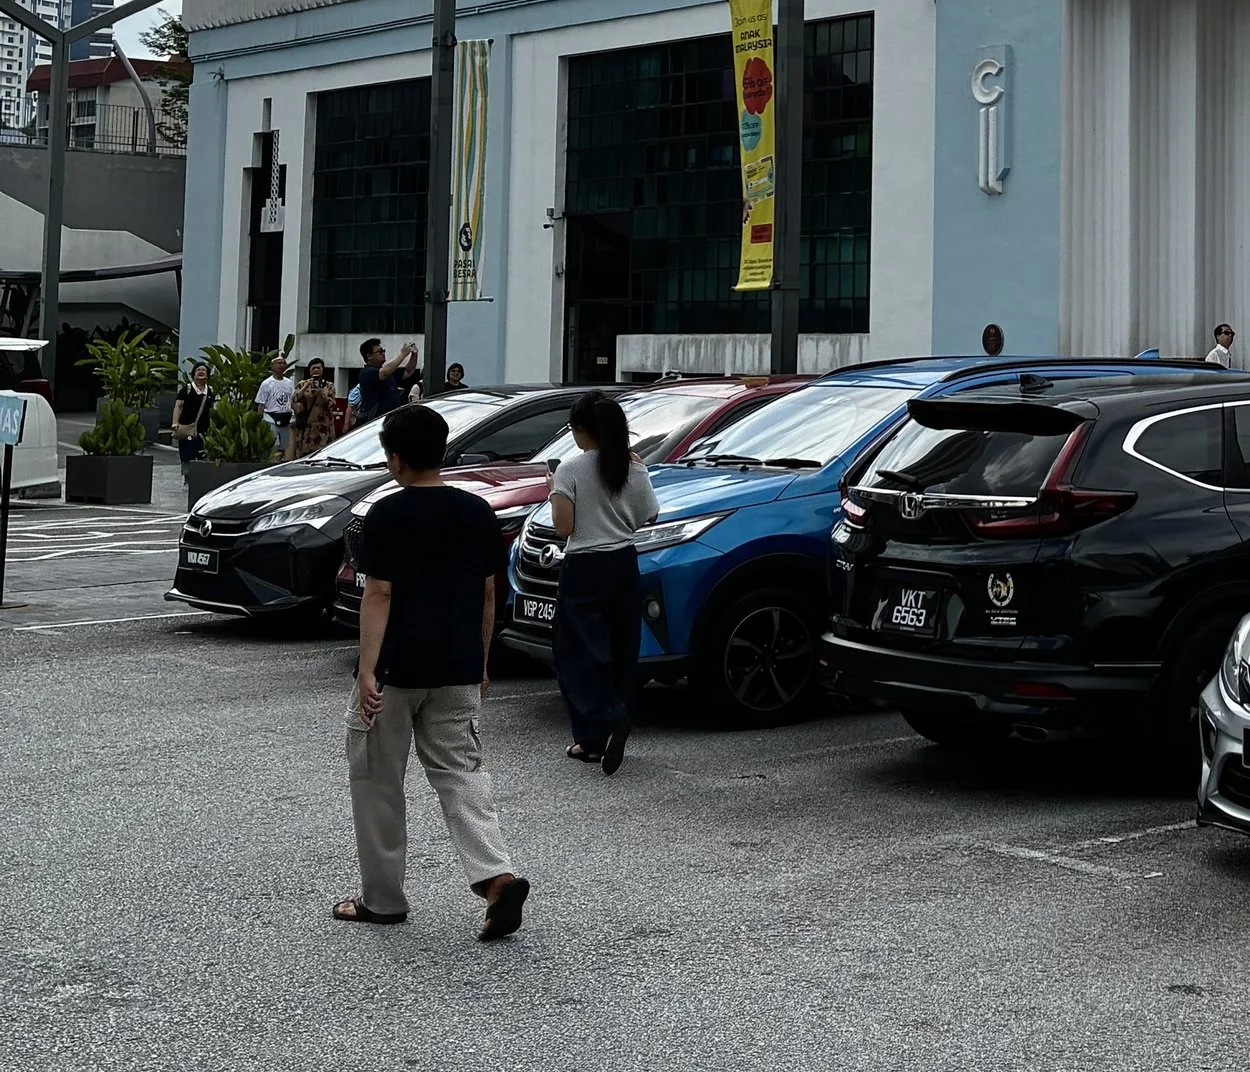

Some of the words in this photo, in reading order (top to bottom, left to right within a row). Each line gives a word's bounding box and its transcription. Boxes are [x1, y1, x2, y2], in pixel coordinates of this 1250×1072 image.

[900, 588, 926, 609] VKT
[524, 599, 538, 617] VGP
[537, 601, 556, 620] 245
[892, 605, 927, 627] 6563
